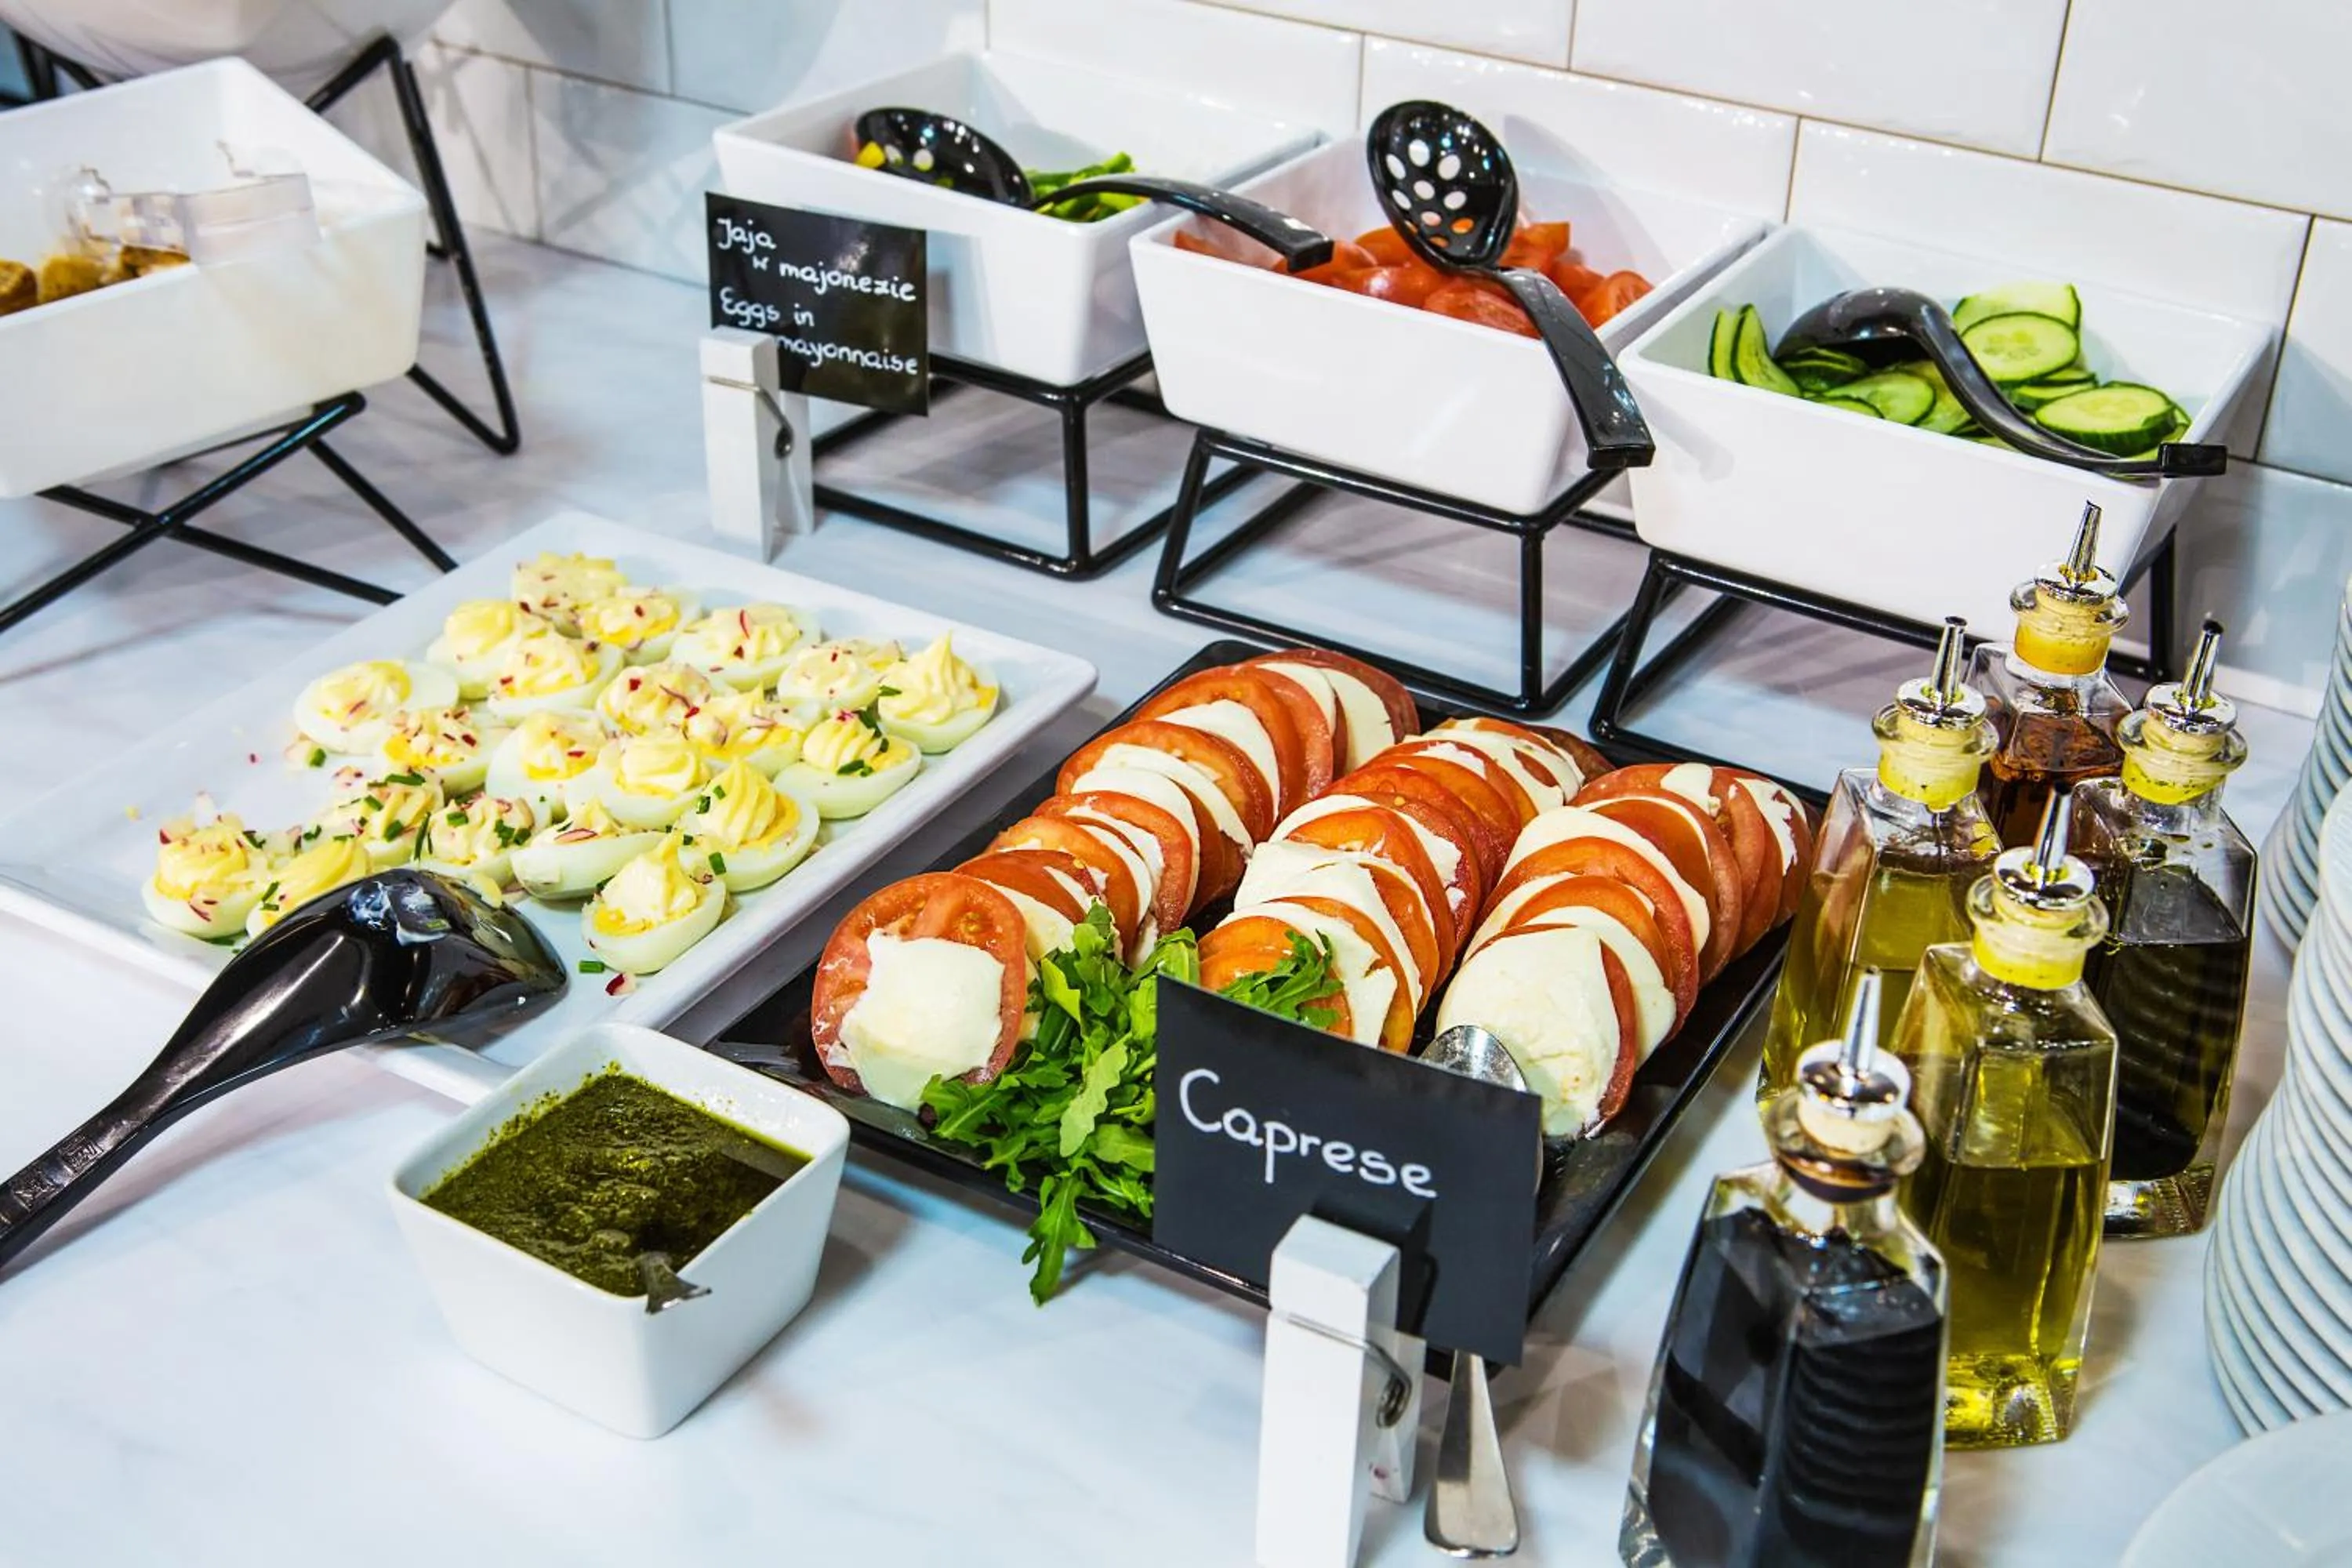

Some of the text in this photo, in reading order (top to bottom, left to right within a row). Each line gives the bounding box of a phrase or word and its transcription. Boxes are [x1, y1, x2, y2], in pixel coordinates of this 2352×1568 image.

[717, 218, 776, 253] Jaja
[753, 255, 916, 300] w majonezie
[720, 287, 815, 328] Eggs in
[775, 335, 917, 374] mayonnaise
[1179, 1068, 1437, 1198] Caprese
